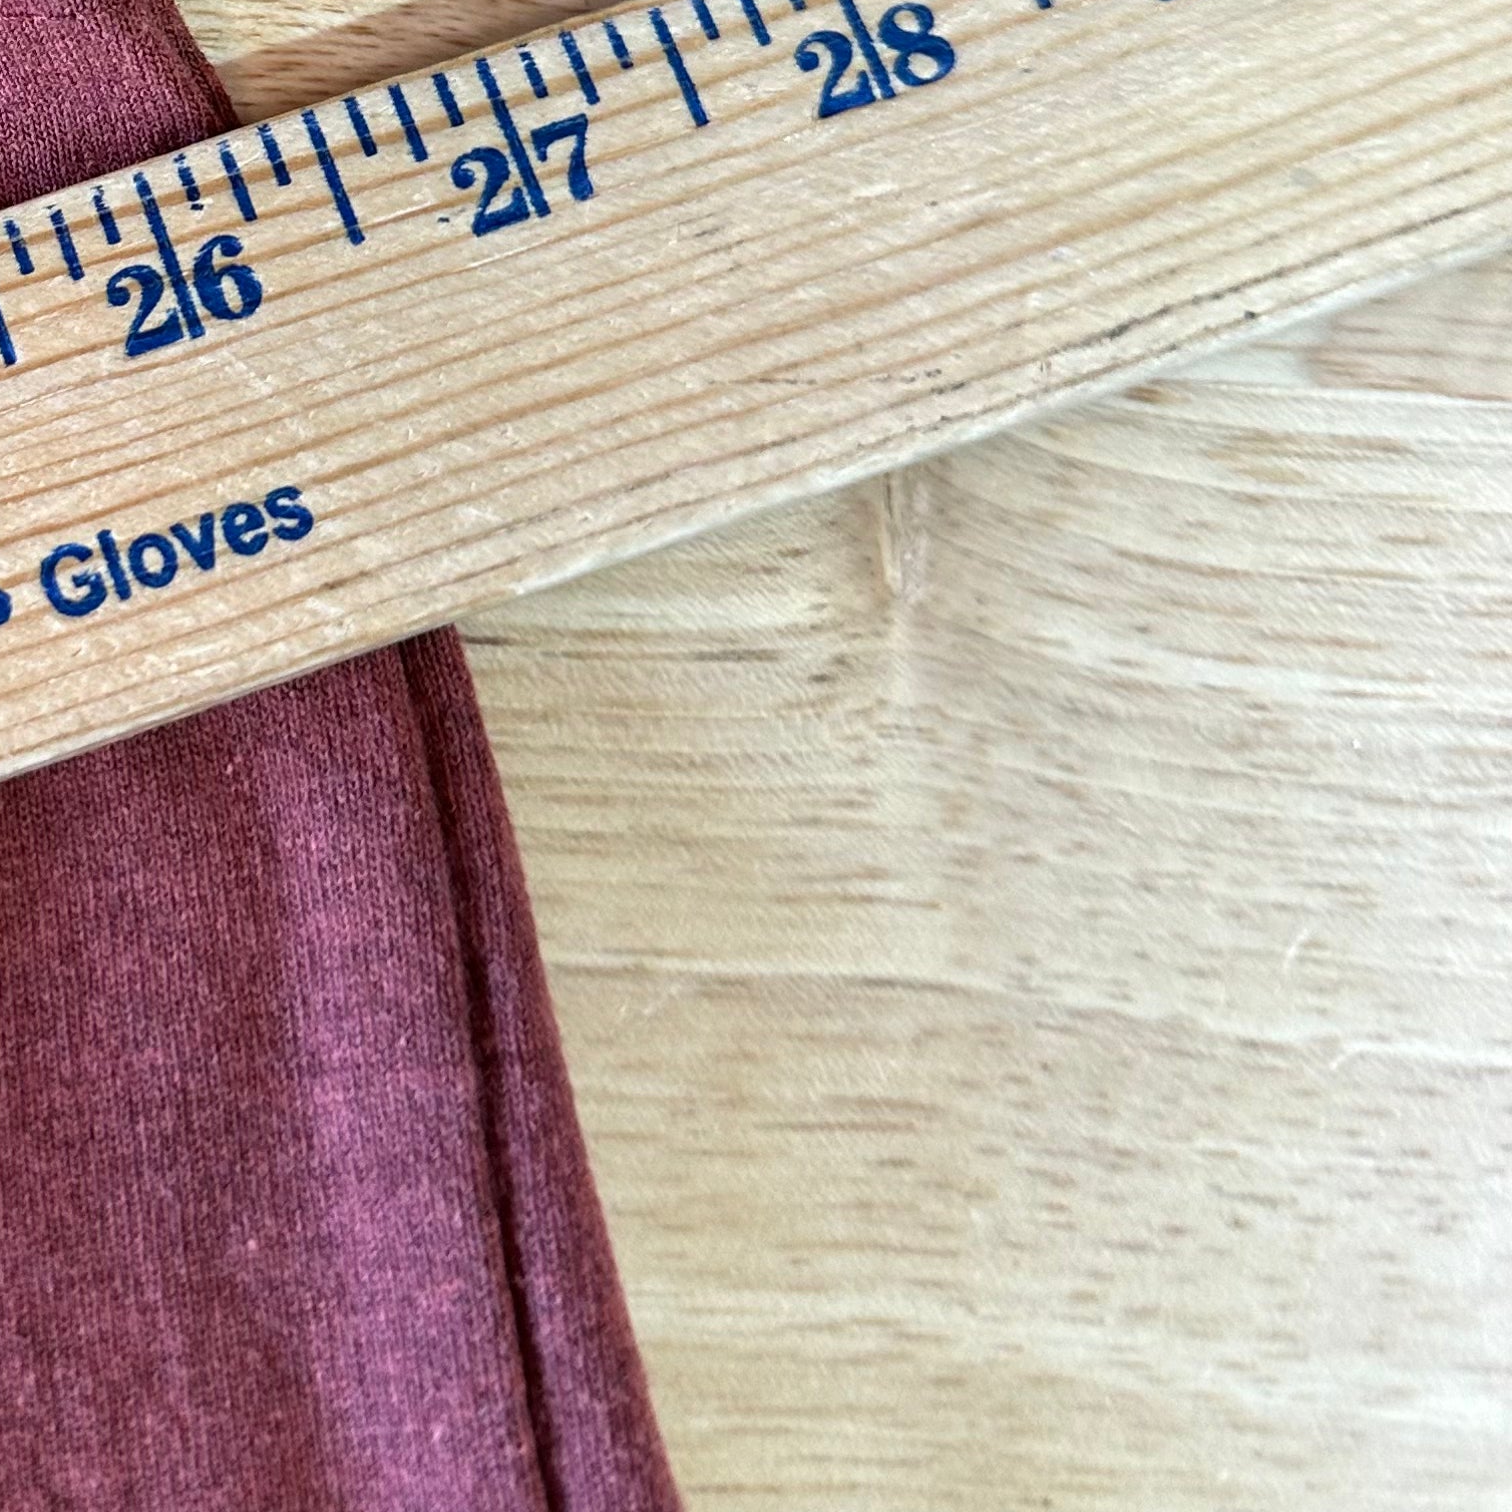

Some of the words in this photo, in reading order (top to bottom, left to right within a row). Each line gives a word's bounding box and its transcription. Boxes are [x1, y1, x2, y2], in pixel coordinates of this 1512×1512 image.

[107, 235, 262, 357] 26
[451, 114, 593, 236] 27
[795, 3, 956, 118] 28
[40, 486, 314, 617] Gloves
